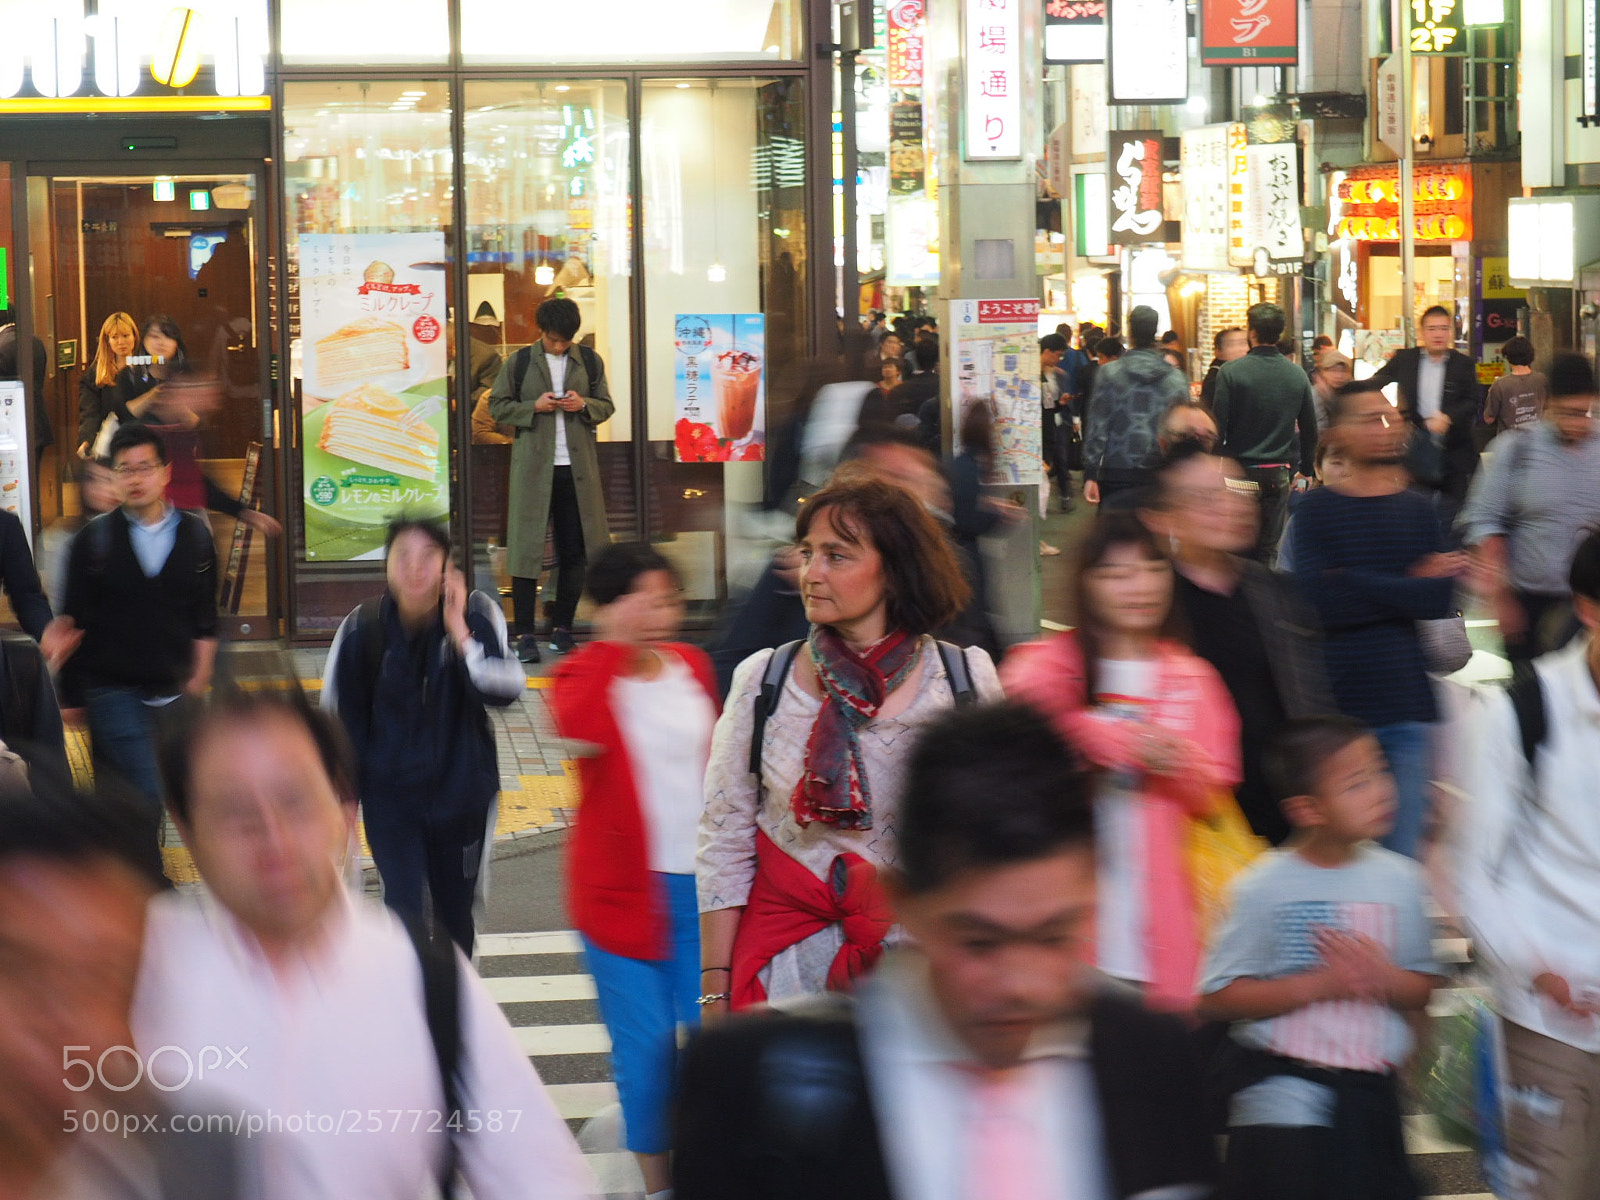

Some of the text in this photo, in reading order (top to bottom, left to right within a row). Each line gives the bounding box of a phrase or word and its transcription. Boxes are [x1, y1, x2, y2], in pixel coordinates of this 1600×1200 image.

[1411, 0, 1456, 23] 1F
[1410, 27, 1458, 52] 2F
[288, 304, 299, 314] 1F
[360, 292, 434, 312] ミルクレープ
[679, 327, 706, 339] 沖縄
[341, 484, 444, 504] レモンのミルクレープ
